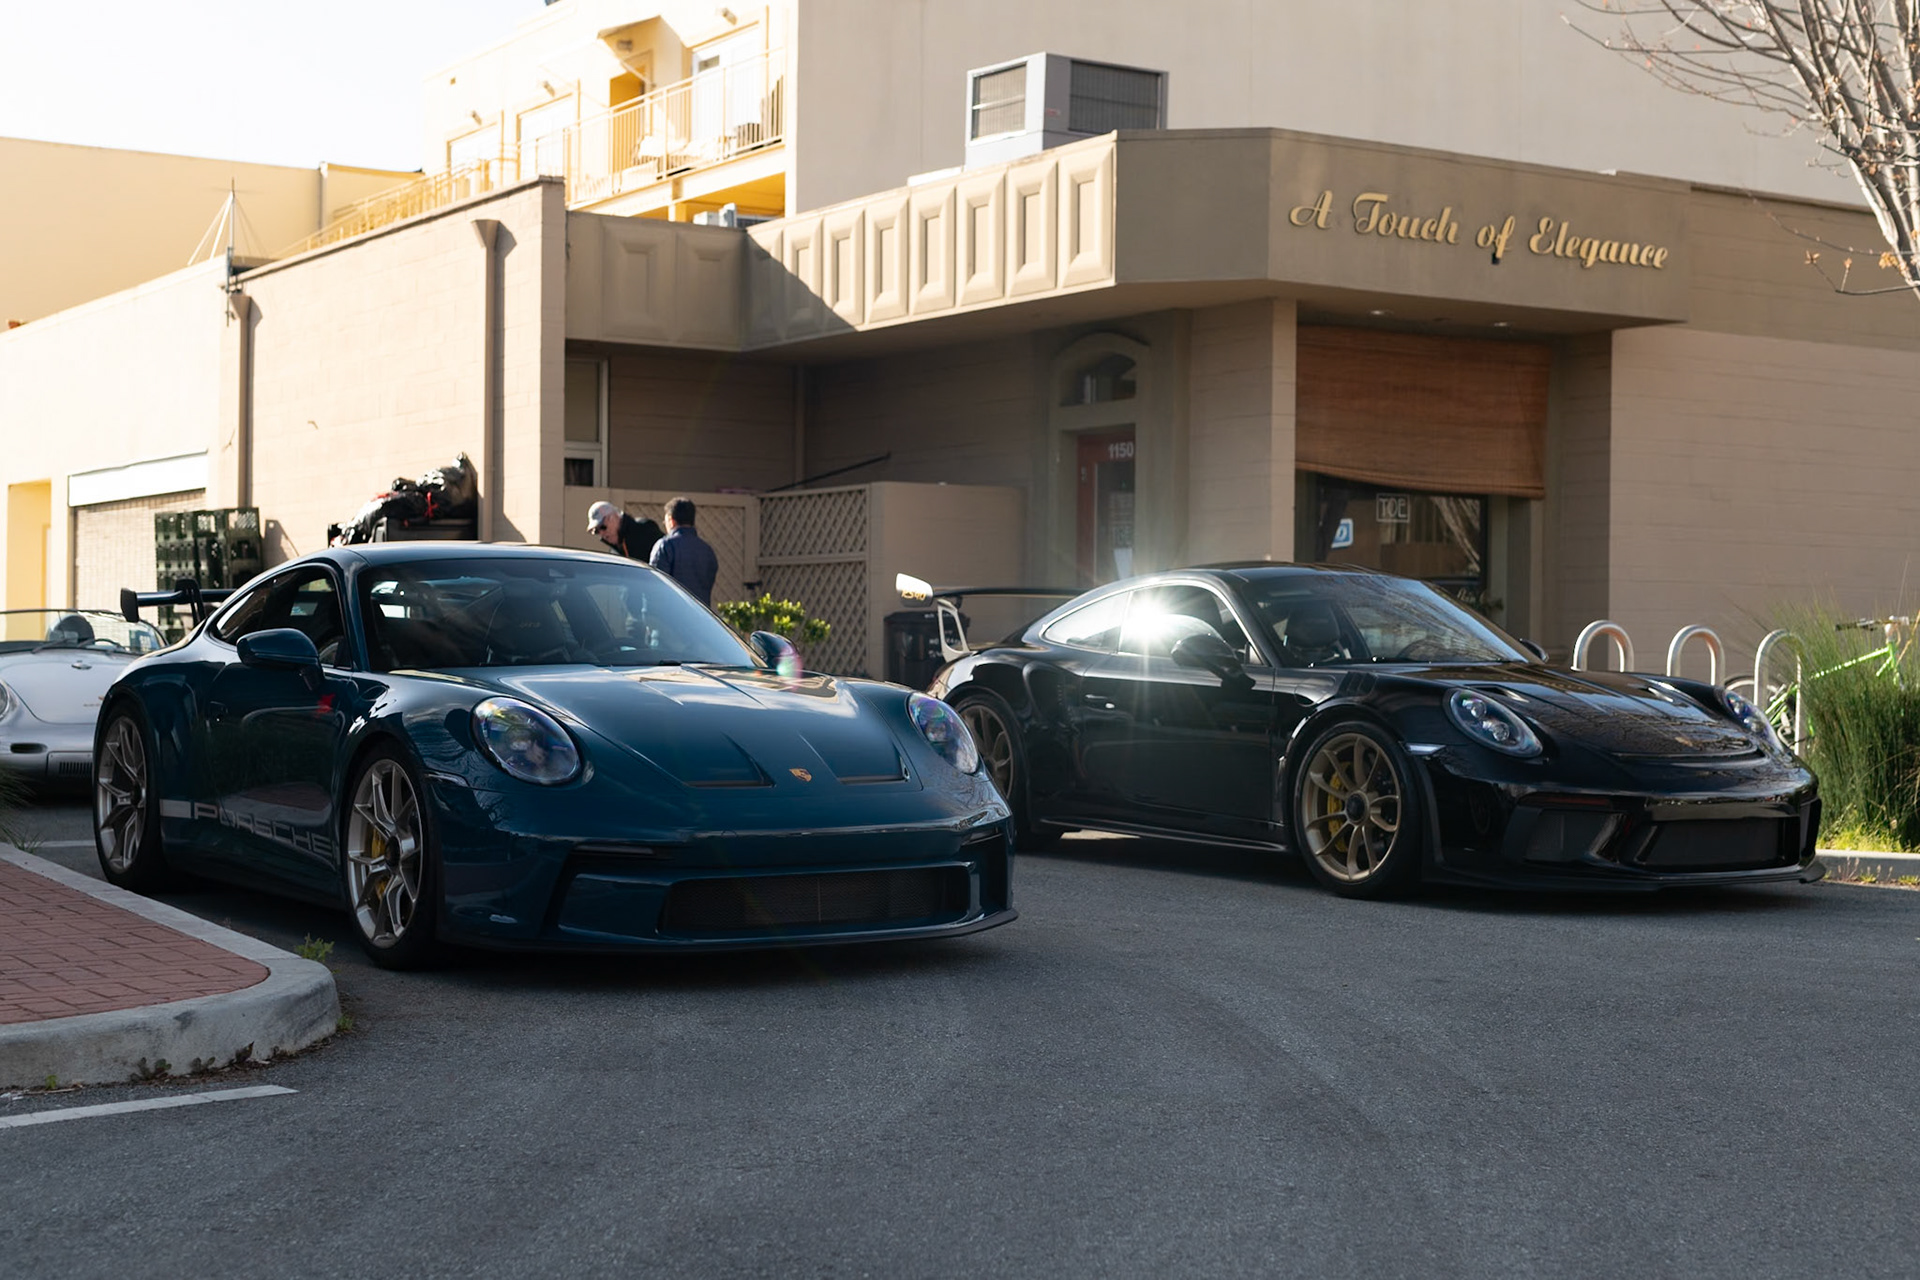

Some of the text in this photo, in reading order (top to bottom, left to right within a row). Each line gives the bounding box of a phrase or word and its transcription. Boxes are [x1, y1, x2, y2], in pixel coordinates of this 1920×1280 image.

[1288, 189, 1669, 269] A Touch of Elegance
[1108, 441, 1134, 459] 1150
[1379, 497, 1408, 518] TOE
[194, 802, 333, 857] PORSCHE
